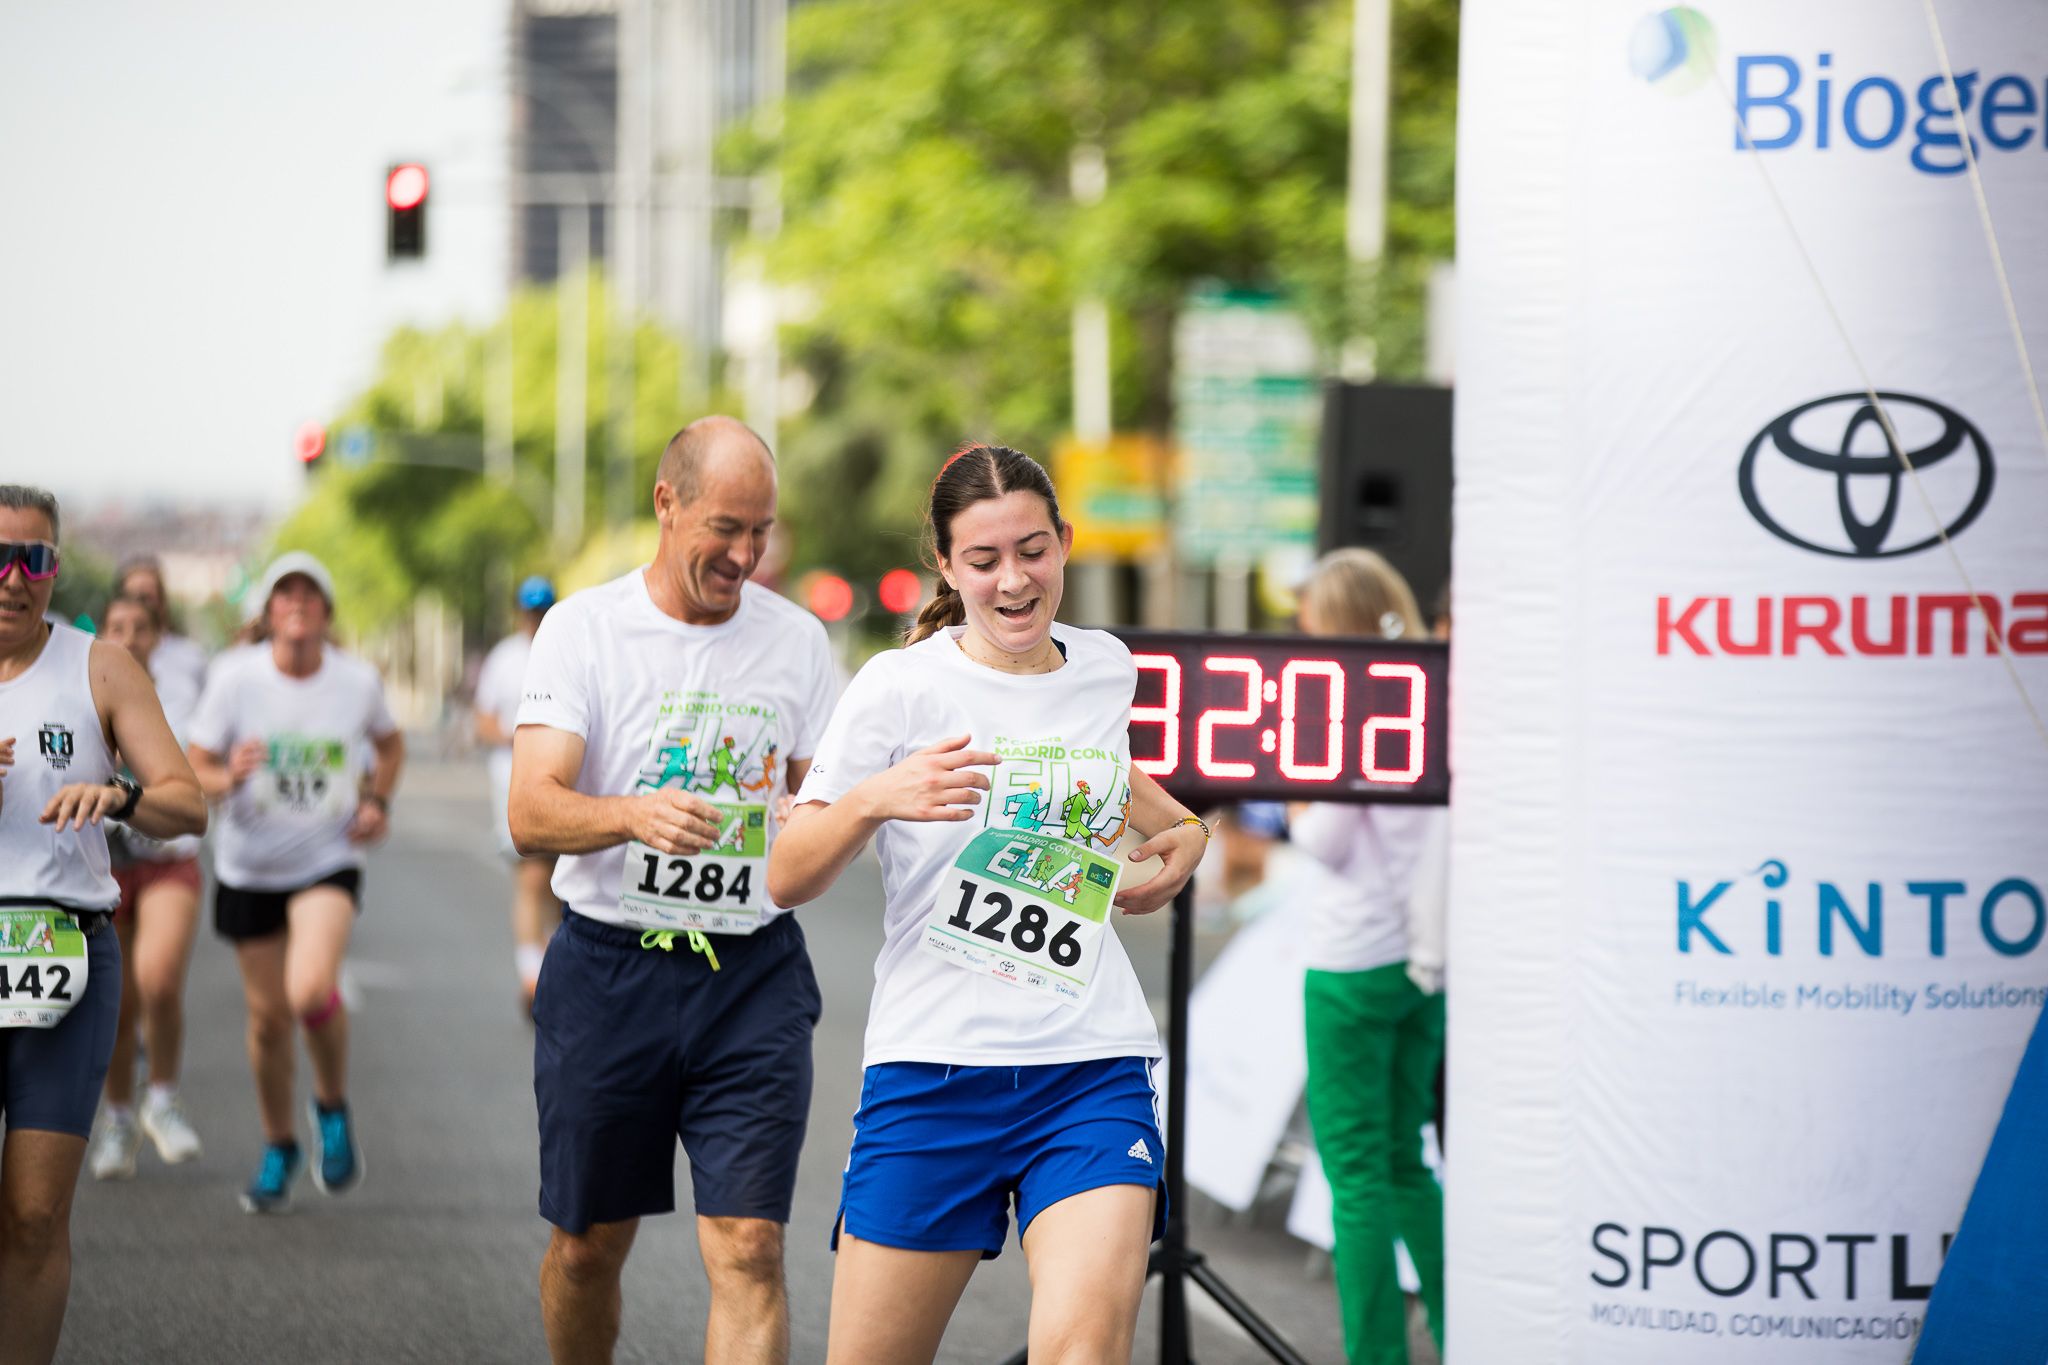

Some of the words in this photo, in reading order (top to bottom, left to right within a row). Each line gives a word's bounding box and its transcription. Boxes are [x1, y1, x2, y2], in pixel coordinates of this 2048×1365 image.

[1734, 53, 2048, 175] Bioge
[994, 745, 1066, 760] MADRID
[1070, 747, 1106, 761] CON
[985, 840, 1082, 905] ELA
[1014, 834, 1049, 847] MADRID
[1048, 842, 1071, 855] CON
[1071, 850, 1083, 861] LA
[638, 853, 751, 905] 1284
[947, 878, 1083, 968] 1286
[1675, 981, 1787, 1009] Flexible
[1798, 983, 1916, 1016] Mobility
[1924, 981, 2047, 1010] Solutions
[1590, 1222, 1956, 1301] SPORTL
[1591, 1302, 1724, 1337] MOVILIDAD,
